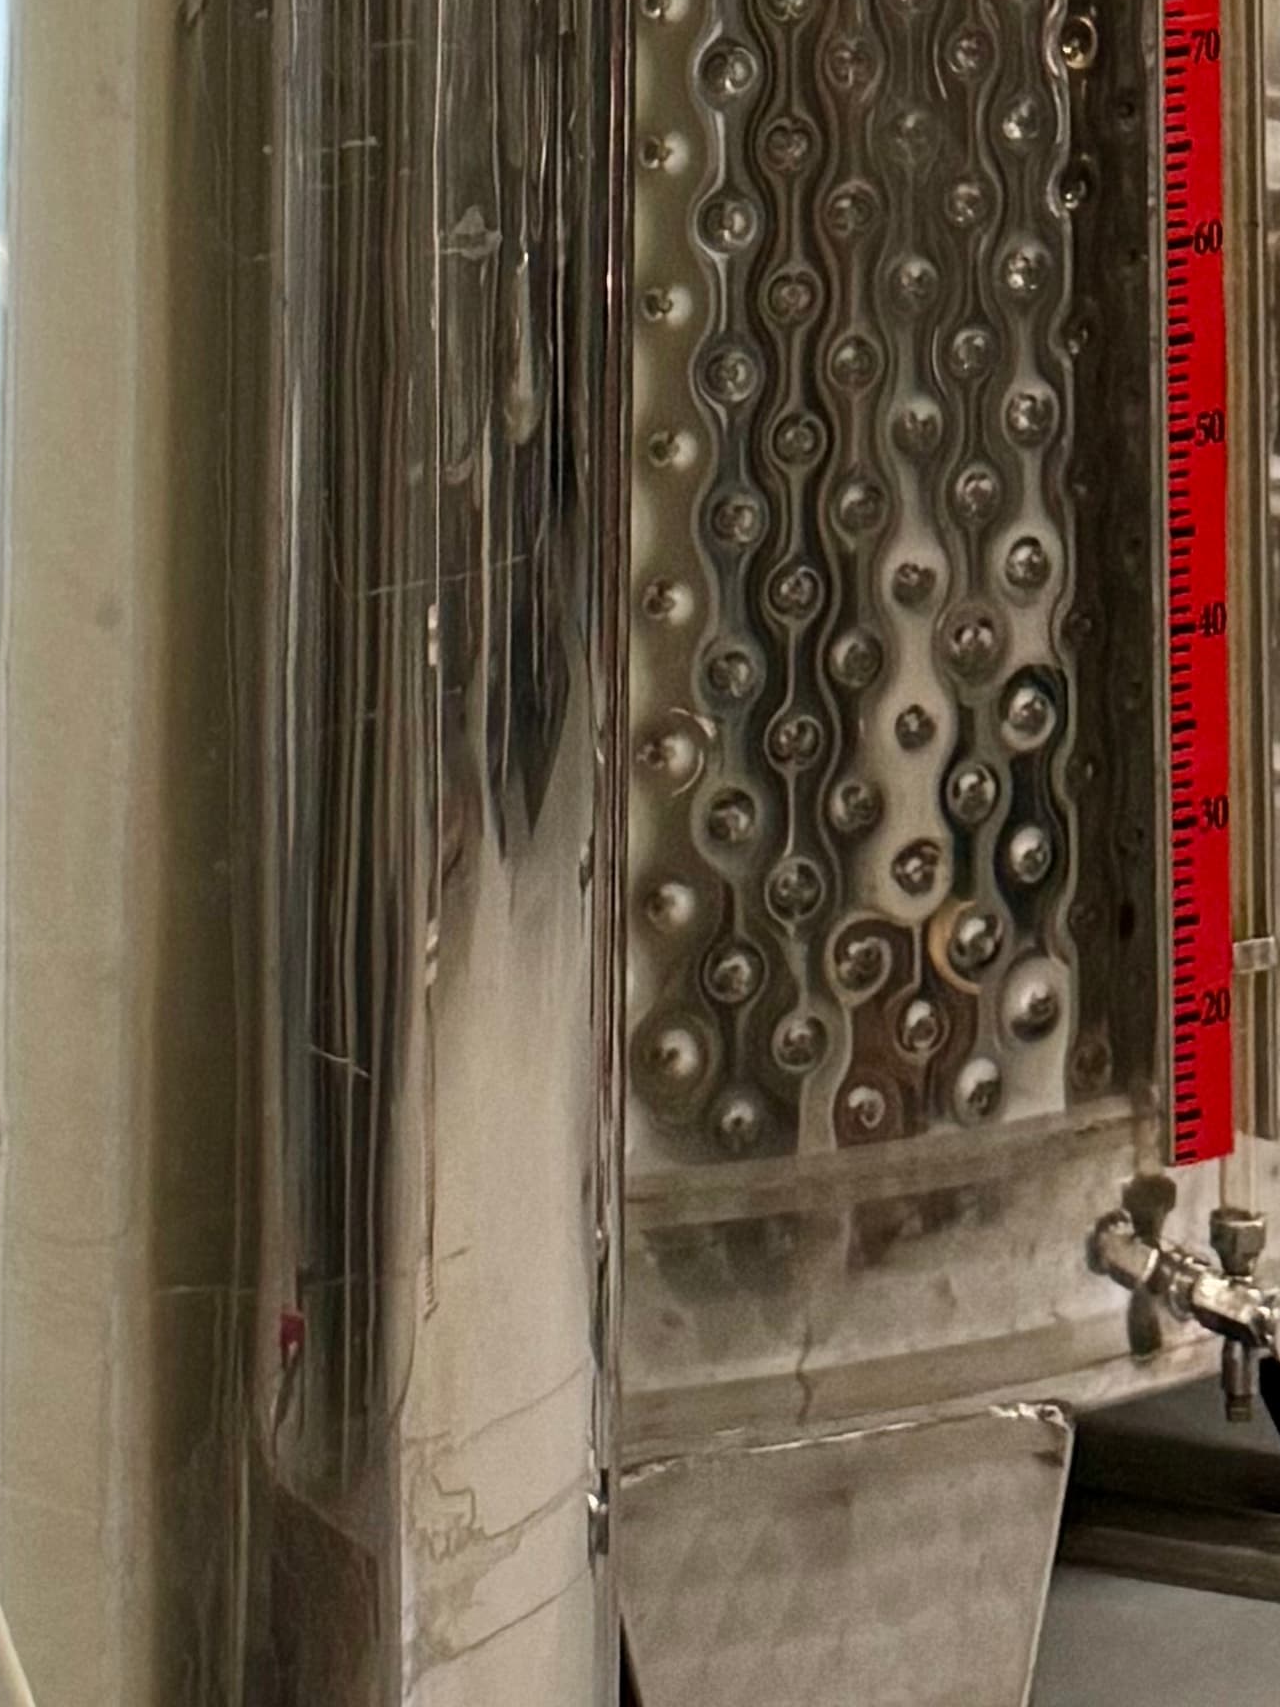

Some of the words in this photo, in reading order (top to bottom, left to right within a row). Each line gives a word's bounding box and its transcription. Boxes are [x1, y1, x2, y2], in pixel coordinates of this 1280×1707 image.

[1191, 28, 1220, 64] 70
[1192, 219, 1223, 255] 60
[1195, 409, 1225, 447] 50
[1197, 601, 1227, 638] 40
[1200, 794, 1229, 833] 30
[1200, 988, 1230, 1026] 20
